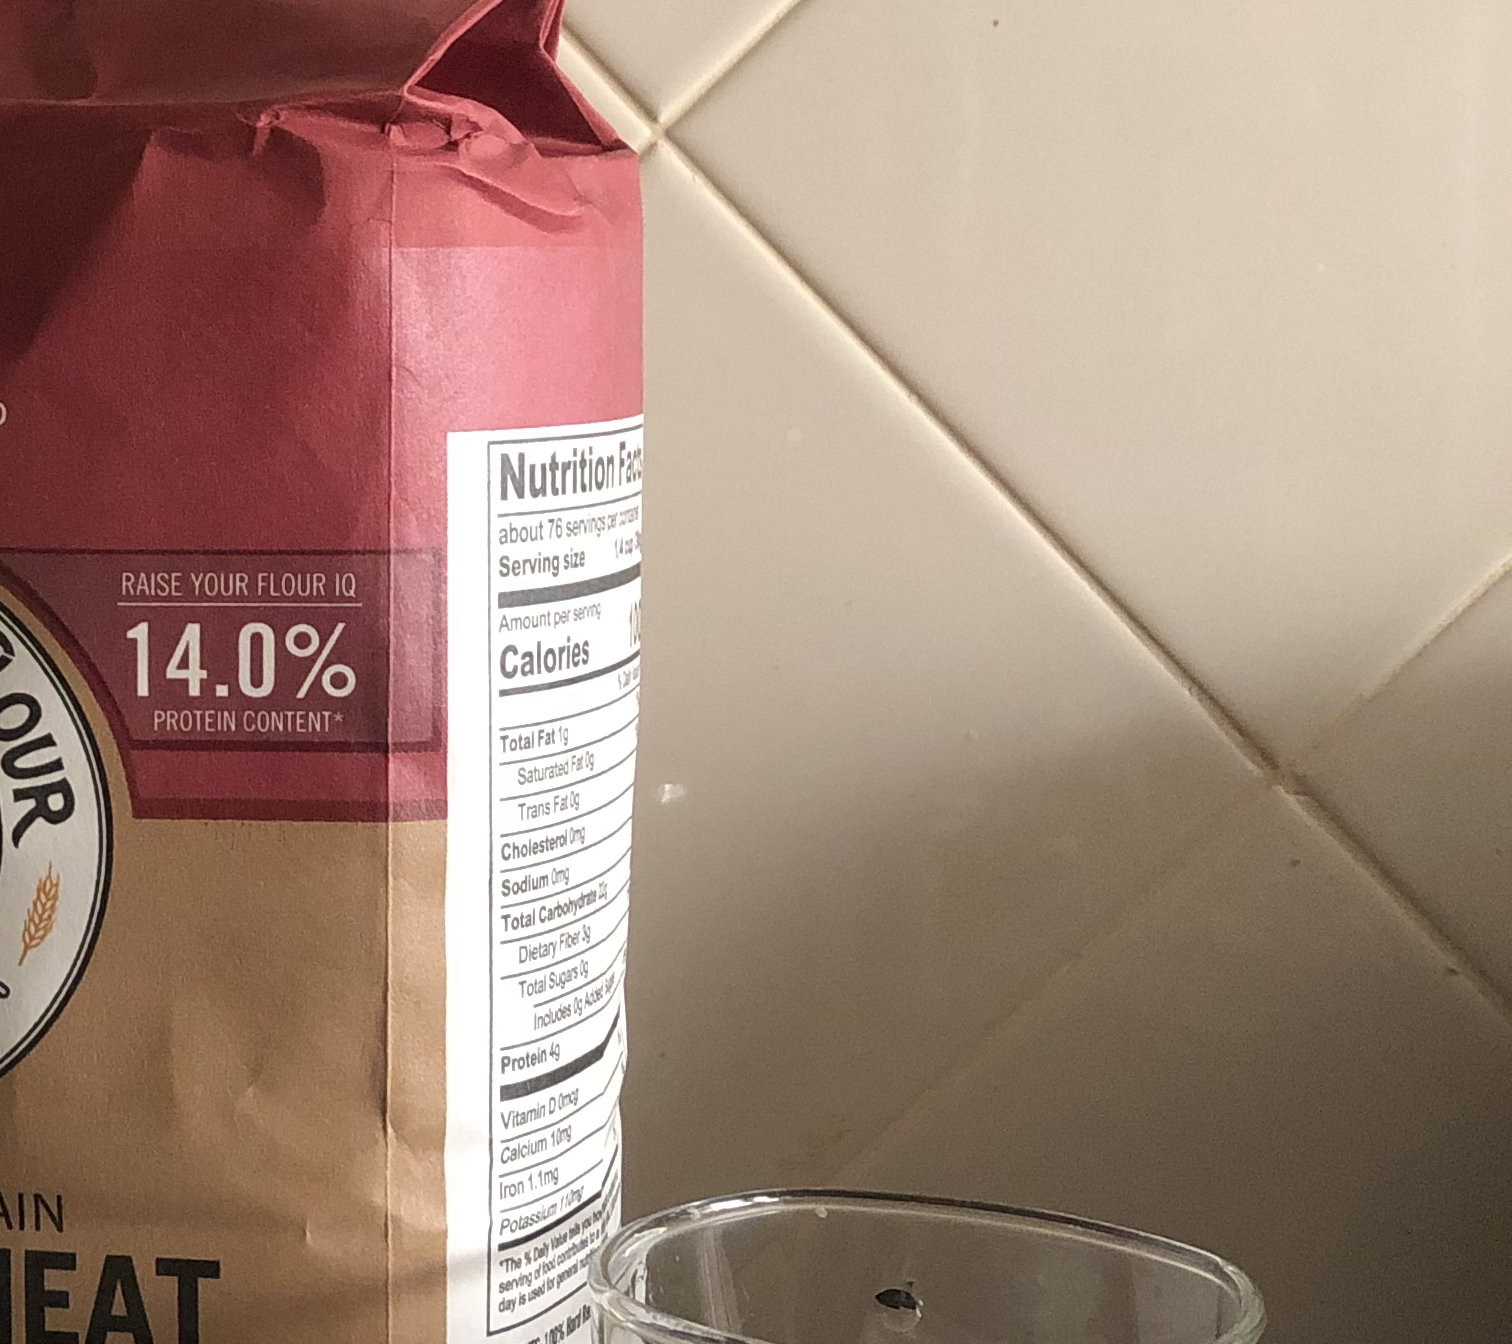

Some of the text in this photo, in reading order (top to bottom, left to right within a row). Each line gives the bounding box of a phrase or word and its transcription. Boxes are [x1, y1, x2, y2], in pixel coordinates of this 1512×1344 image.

[500, 445, 615, 501] Nutrition
[498, 520, 544, 545] about
[548, 517, 563, 540] 76
[566, 513, 605, 537] servings
[498, 551, 560, 577] Serving
[563, 547, 586, 570] size
[120, 570, 358, 599] RAISE YOUR FLOUR IQ
[498, 602, 602, 633] Amount per serving
[125, 620, 357, 700] 14.0%
[499, 635, 590, 680] Calories
[152, 709, 239, 734] PROTEIN
[499, 725, 569, 754] Total Fat 1g
[517, 757, 569, 786] Saturated
[571, 754, 584, 774] Fat
[517, 789, 581, 821] Trans Fat 0g
[500, 828, 568, 862] Cholesterol
[501, 873, 549, 898] Sodium
[500, 907, 536, 933] Total
[538, 888, 597, 924] Carbohydrate
[518, 940, 558, 965] Dietary
[559, 930, 581, 952] Fiber
[518, 974, 547, 999] Total
[548, 965, 579, 990] Sugars
[533, 1002, 572, 1031] Includes
[500, 1041, 561, 1075] Protein 4g
[500, 1101, 547, 1130] Vitamin
[548, 1096, 557, 1116] D
[500, 1123, 572, 1165] Calcium 10mg
[499, 1166, 560, 1201] Iron 1.1mg
[499, 1201, 559, 1236] Potassium
[498, 1271, 534, 1295] serving
[498, 1294, 517, 1314] day
[518, 1290, 527, 1308] is
